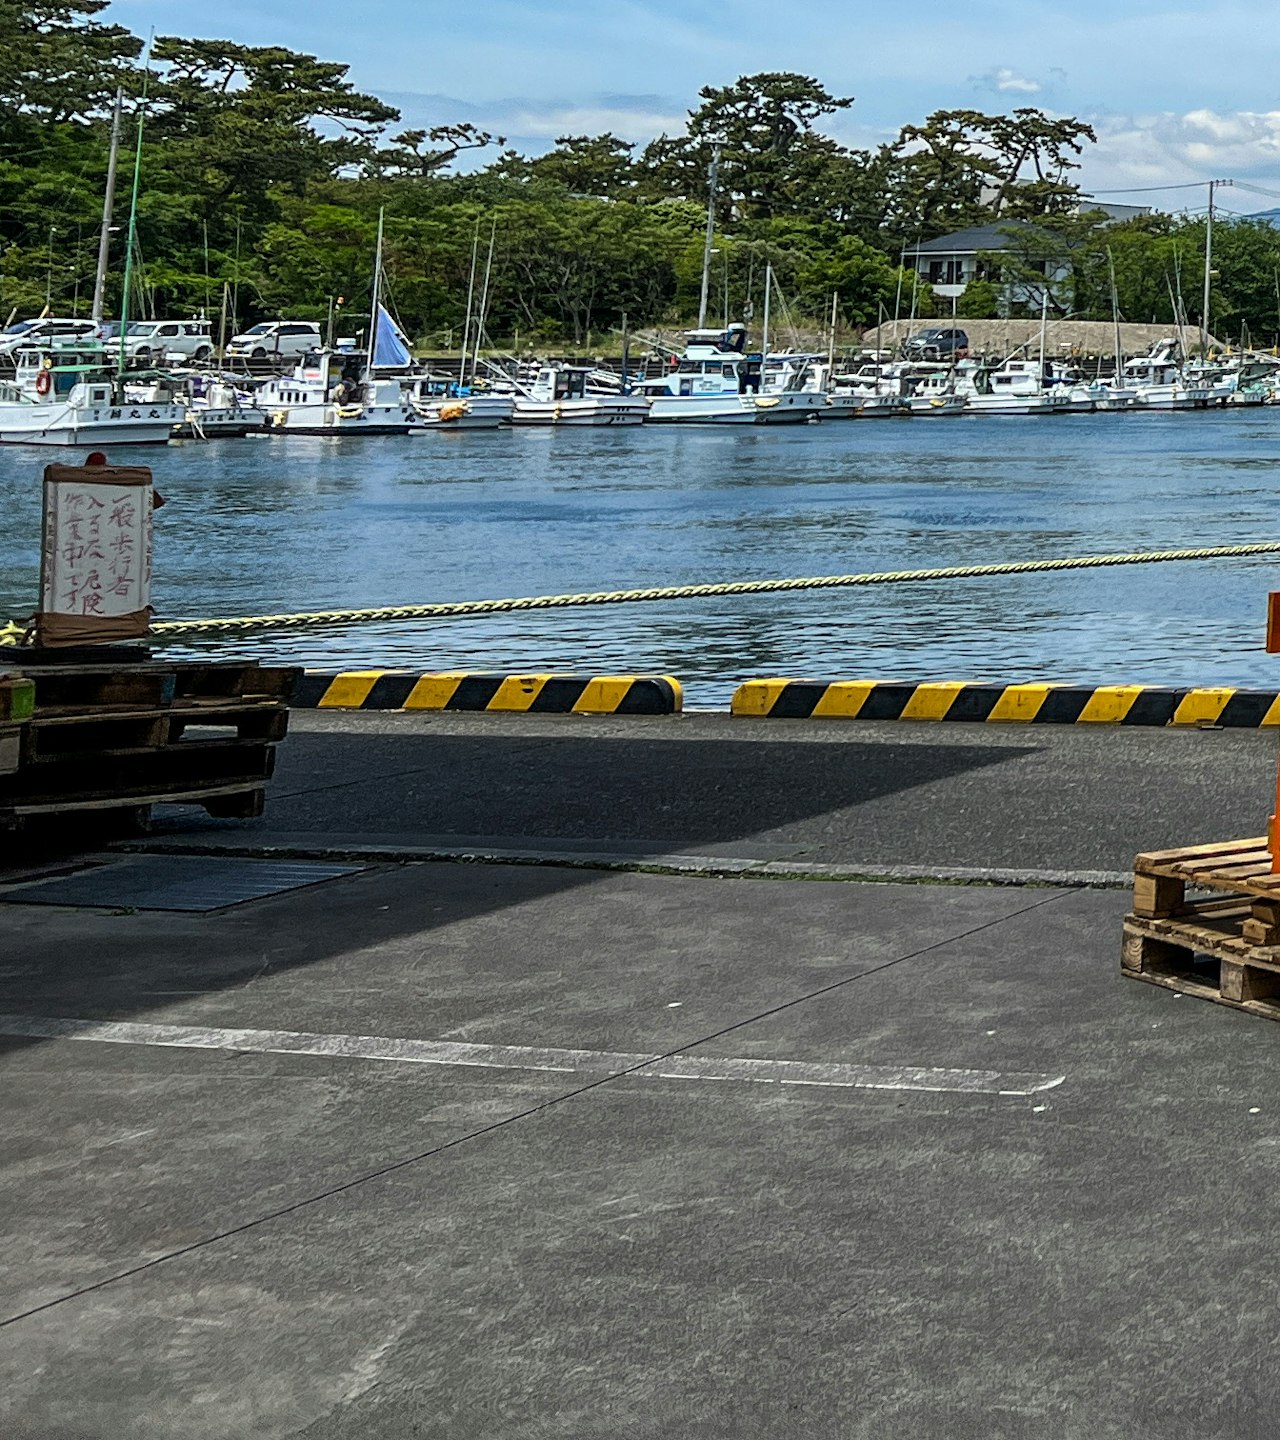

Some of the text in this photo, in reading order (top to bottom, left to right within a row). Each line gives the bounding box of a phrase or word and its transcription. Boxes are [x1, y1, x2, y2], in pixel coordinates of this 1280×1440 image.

[61, 493, 85, 611] 作業中です
[107, 493, 136, 597] 一般歩行者
